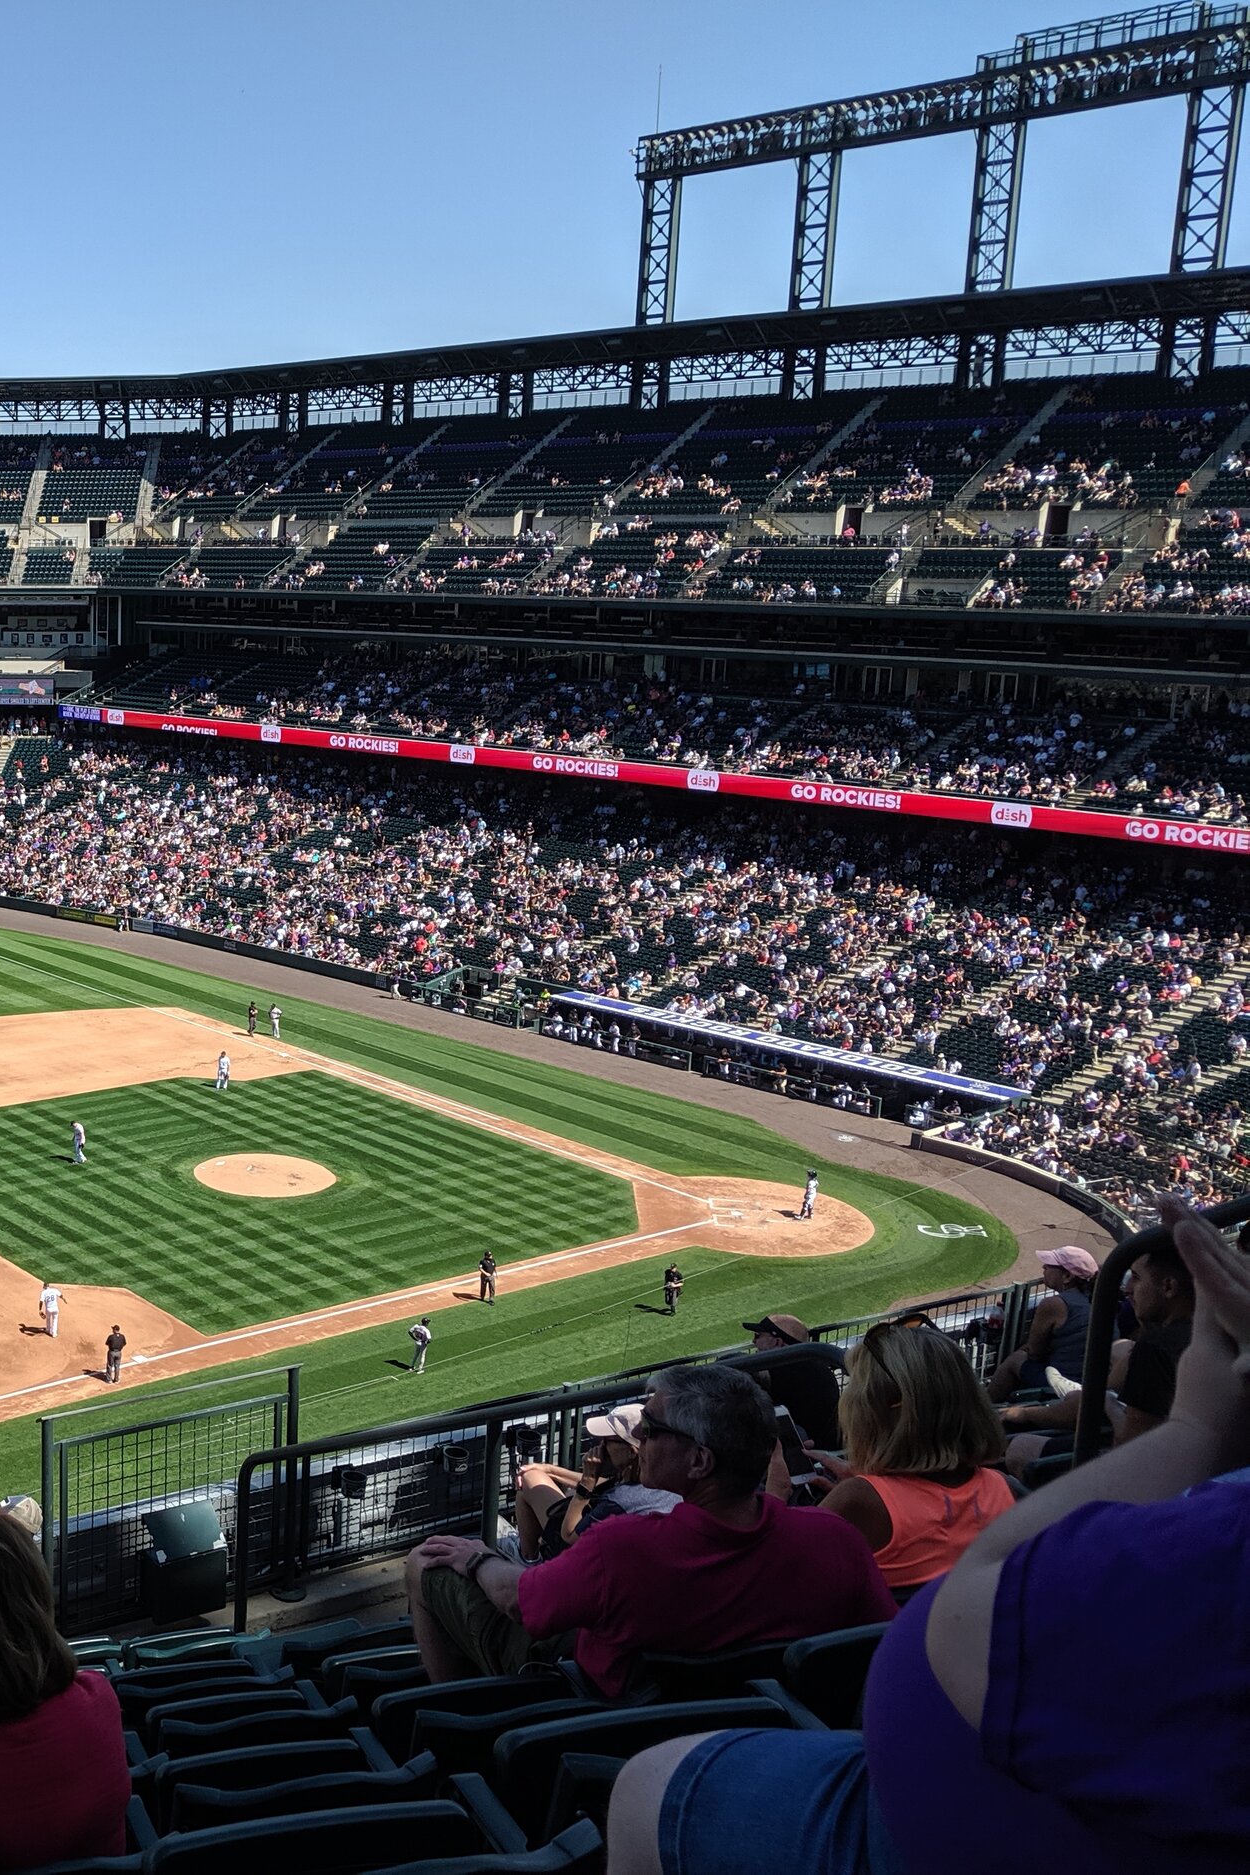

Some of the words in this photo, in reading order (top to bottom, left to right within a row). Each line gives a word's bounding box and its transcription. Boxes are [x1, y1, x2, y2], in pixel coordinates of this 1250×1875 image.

[108, 712, 123, 723] dish
[262, 728, 279, 740] dish
[330, 735, 346, 747] GO
[348, 736, 399, 754] ROCKIES!
[452, 748, 473, 761] dish
[532, 755, 553, 770] GO
[555, 757, 619, 778] ROCKIES!
[690, 773, 716, 789] dish
[790, 784, 817, 801] GO
[820, 786, 902, 810] ROCKIES!
[995, 807, 1028, 824] dish
[1125, 820, 1160, 840] GO
[1164, 824, 1250, 852] ROCKIE
[627, 1006, 751, 1038] ROCKIES
[755, 1032, 928, 1077] COLORADO
[45, 1294, 55, 1303] 28
